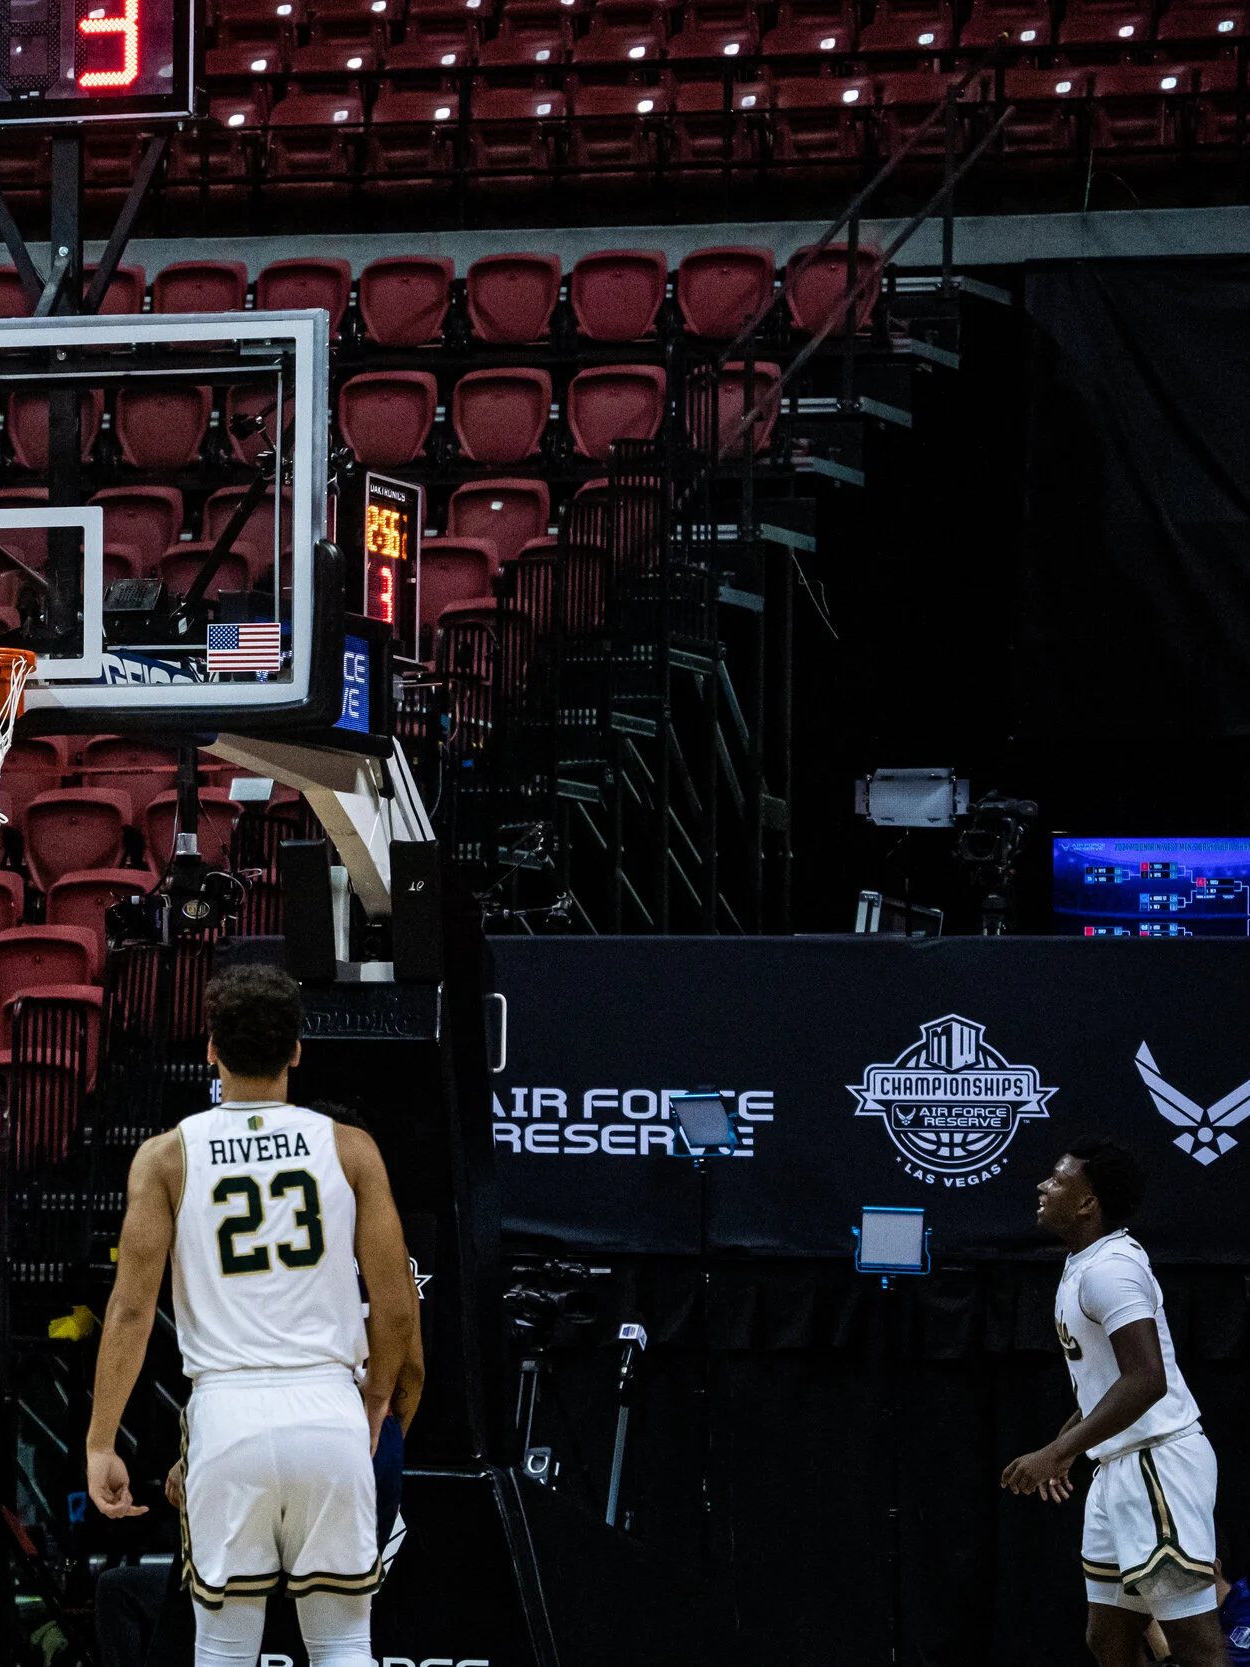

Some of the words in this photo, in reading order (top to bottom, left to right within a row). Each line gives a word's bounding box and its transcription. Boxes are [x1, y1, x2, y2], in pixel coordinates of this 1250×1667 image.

[880, 1076, 1024, 1097] CHAMPIONSHIPS
[919, 1107, 948, 1117] AIR
[952, 1107, 1007, 1118] FORCE
[924, 1117, 1002, 1127] RESERVE
[209, 1132, 310, 1164] RIVERA
[904, 1162, 936, 1184] LAS
[943, 1163, 1002, 1188] VEGAS
[211, 1168, 326, 1277] 23
